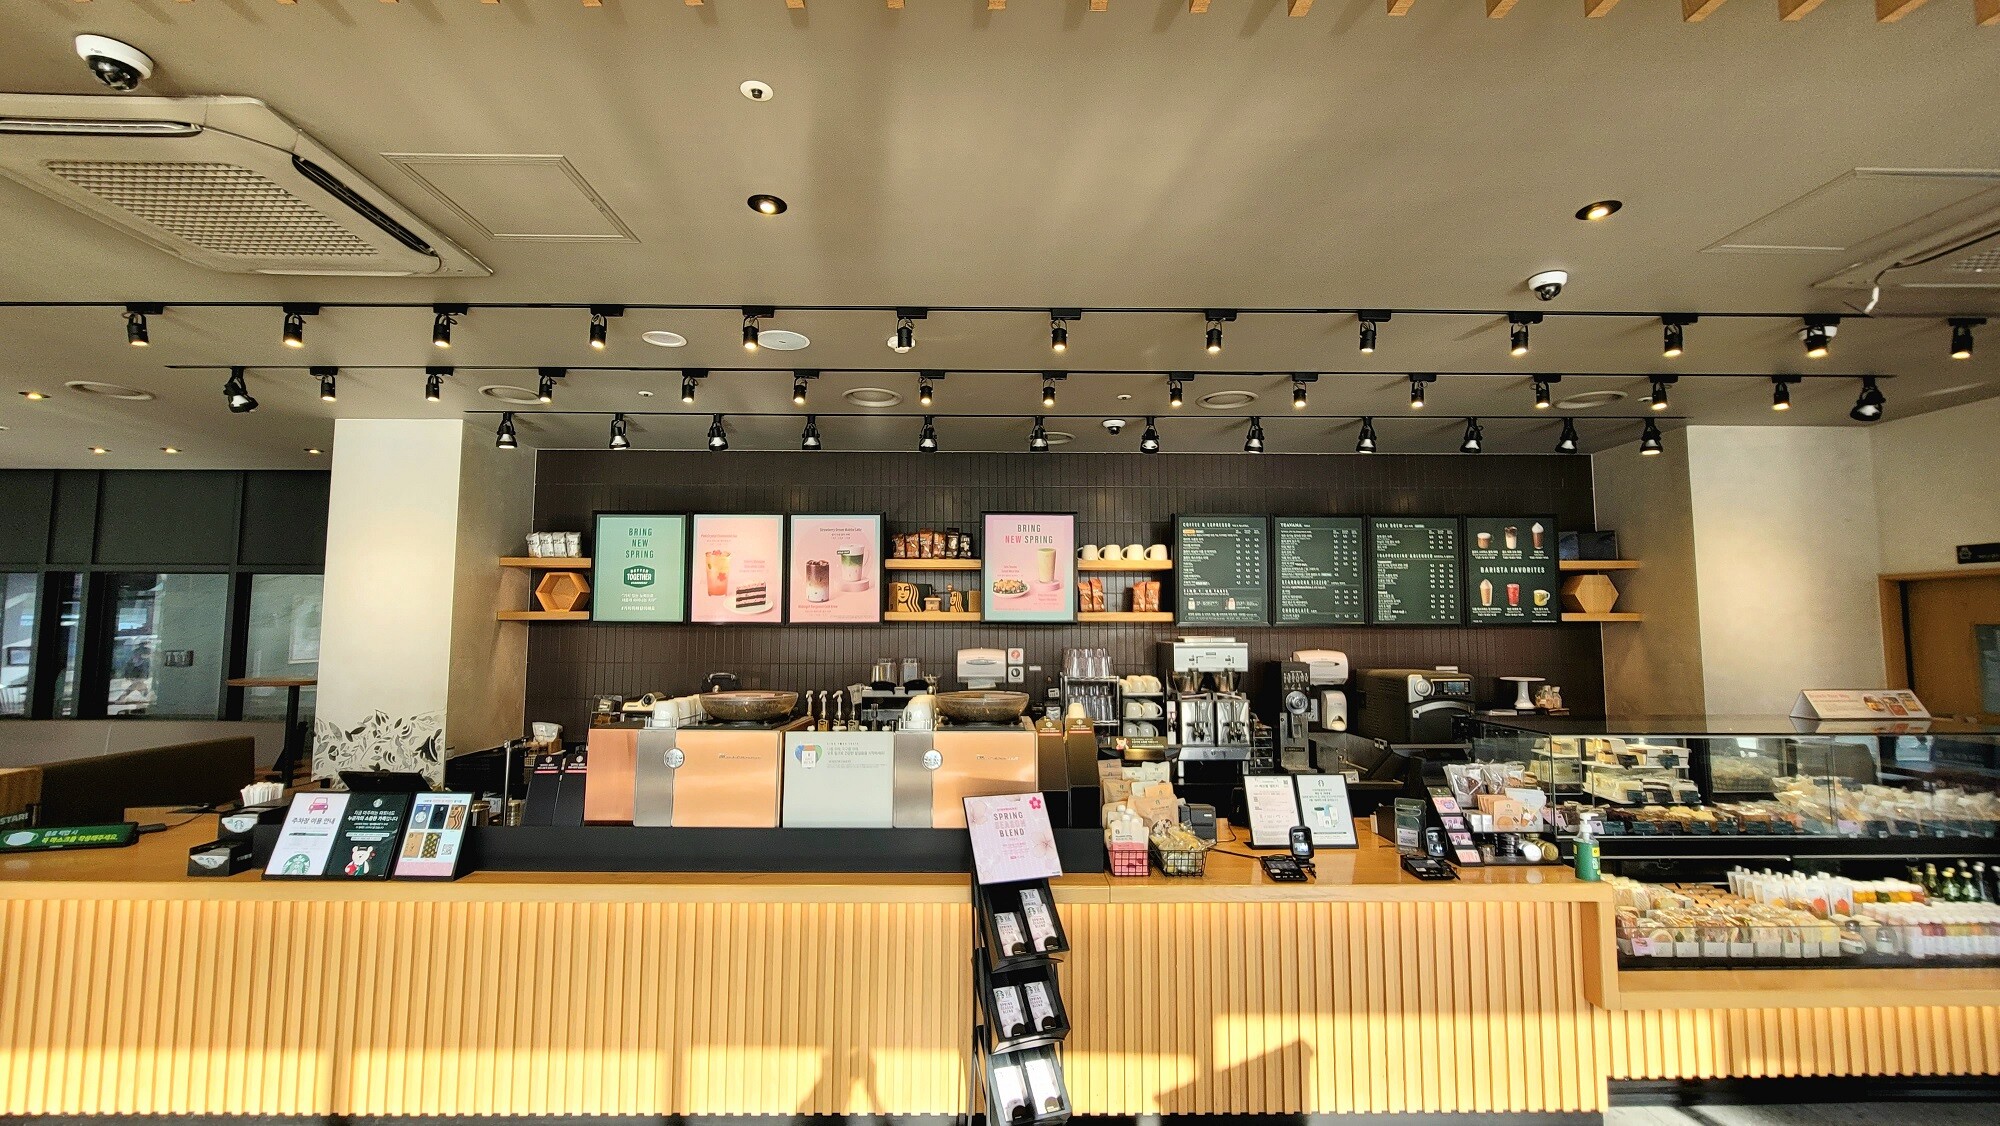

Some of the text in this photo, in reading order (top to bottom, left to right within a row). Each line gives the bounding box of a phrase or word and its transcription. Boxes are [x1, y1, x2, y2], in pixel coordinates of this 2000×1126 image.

[628, 527, 653, 537] BRING
[1017, 524, 1041, 533] BRING
[631, 538, 649, 548] NEW
[1005, 535, 1053, 544] NEW SPRING
[625, 549, 654, 559] SPRING
[1480, 566, 1546, 574] BARISTA FAVORITES
[626, 573, 652, 581] TOGETHER
[993, 811, 1024, 821] SPRING
[291, 817, 336, 825] 주차장 이용 안내
[995, 819, 1026, 829] SEASON
[999, 828, 1025, 837] BLEND
